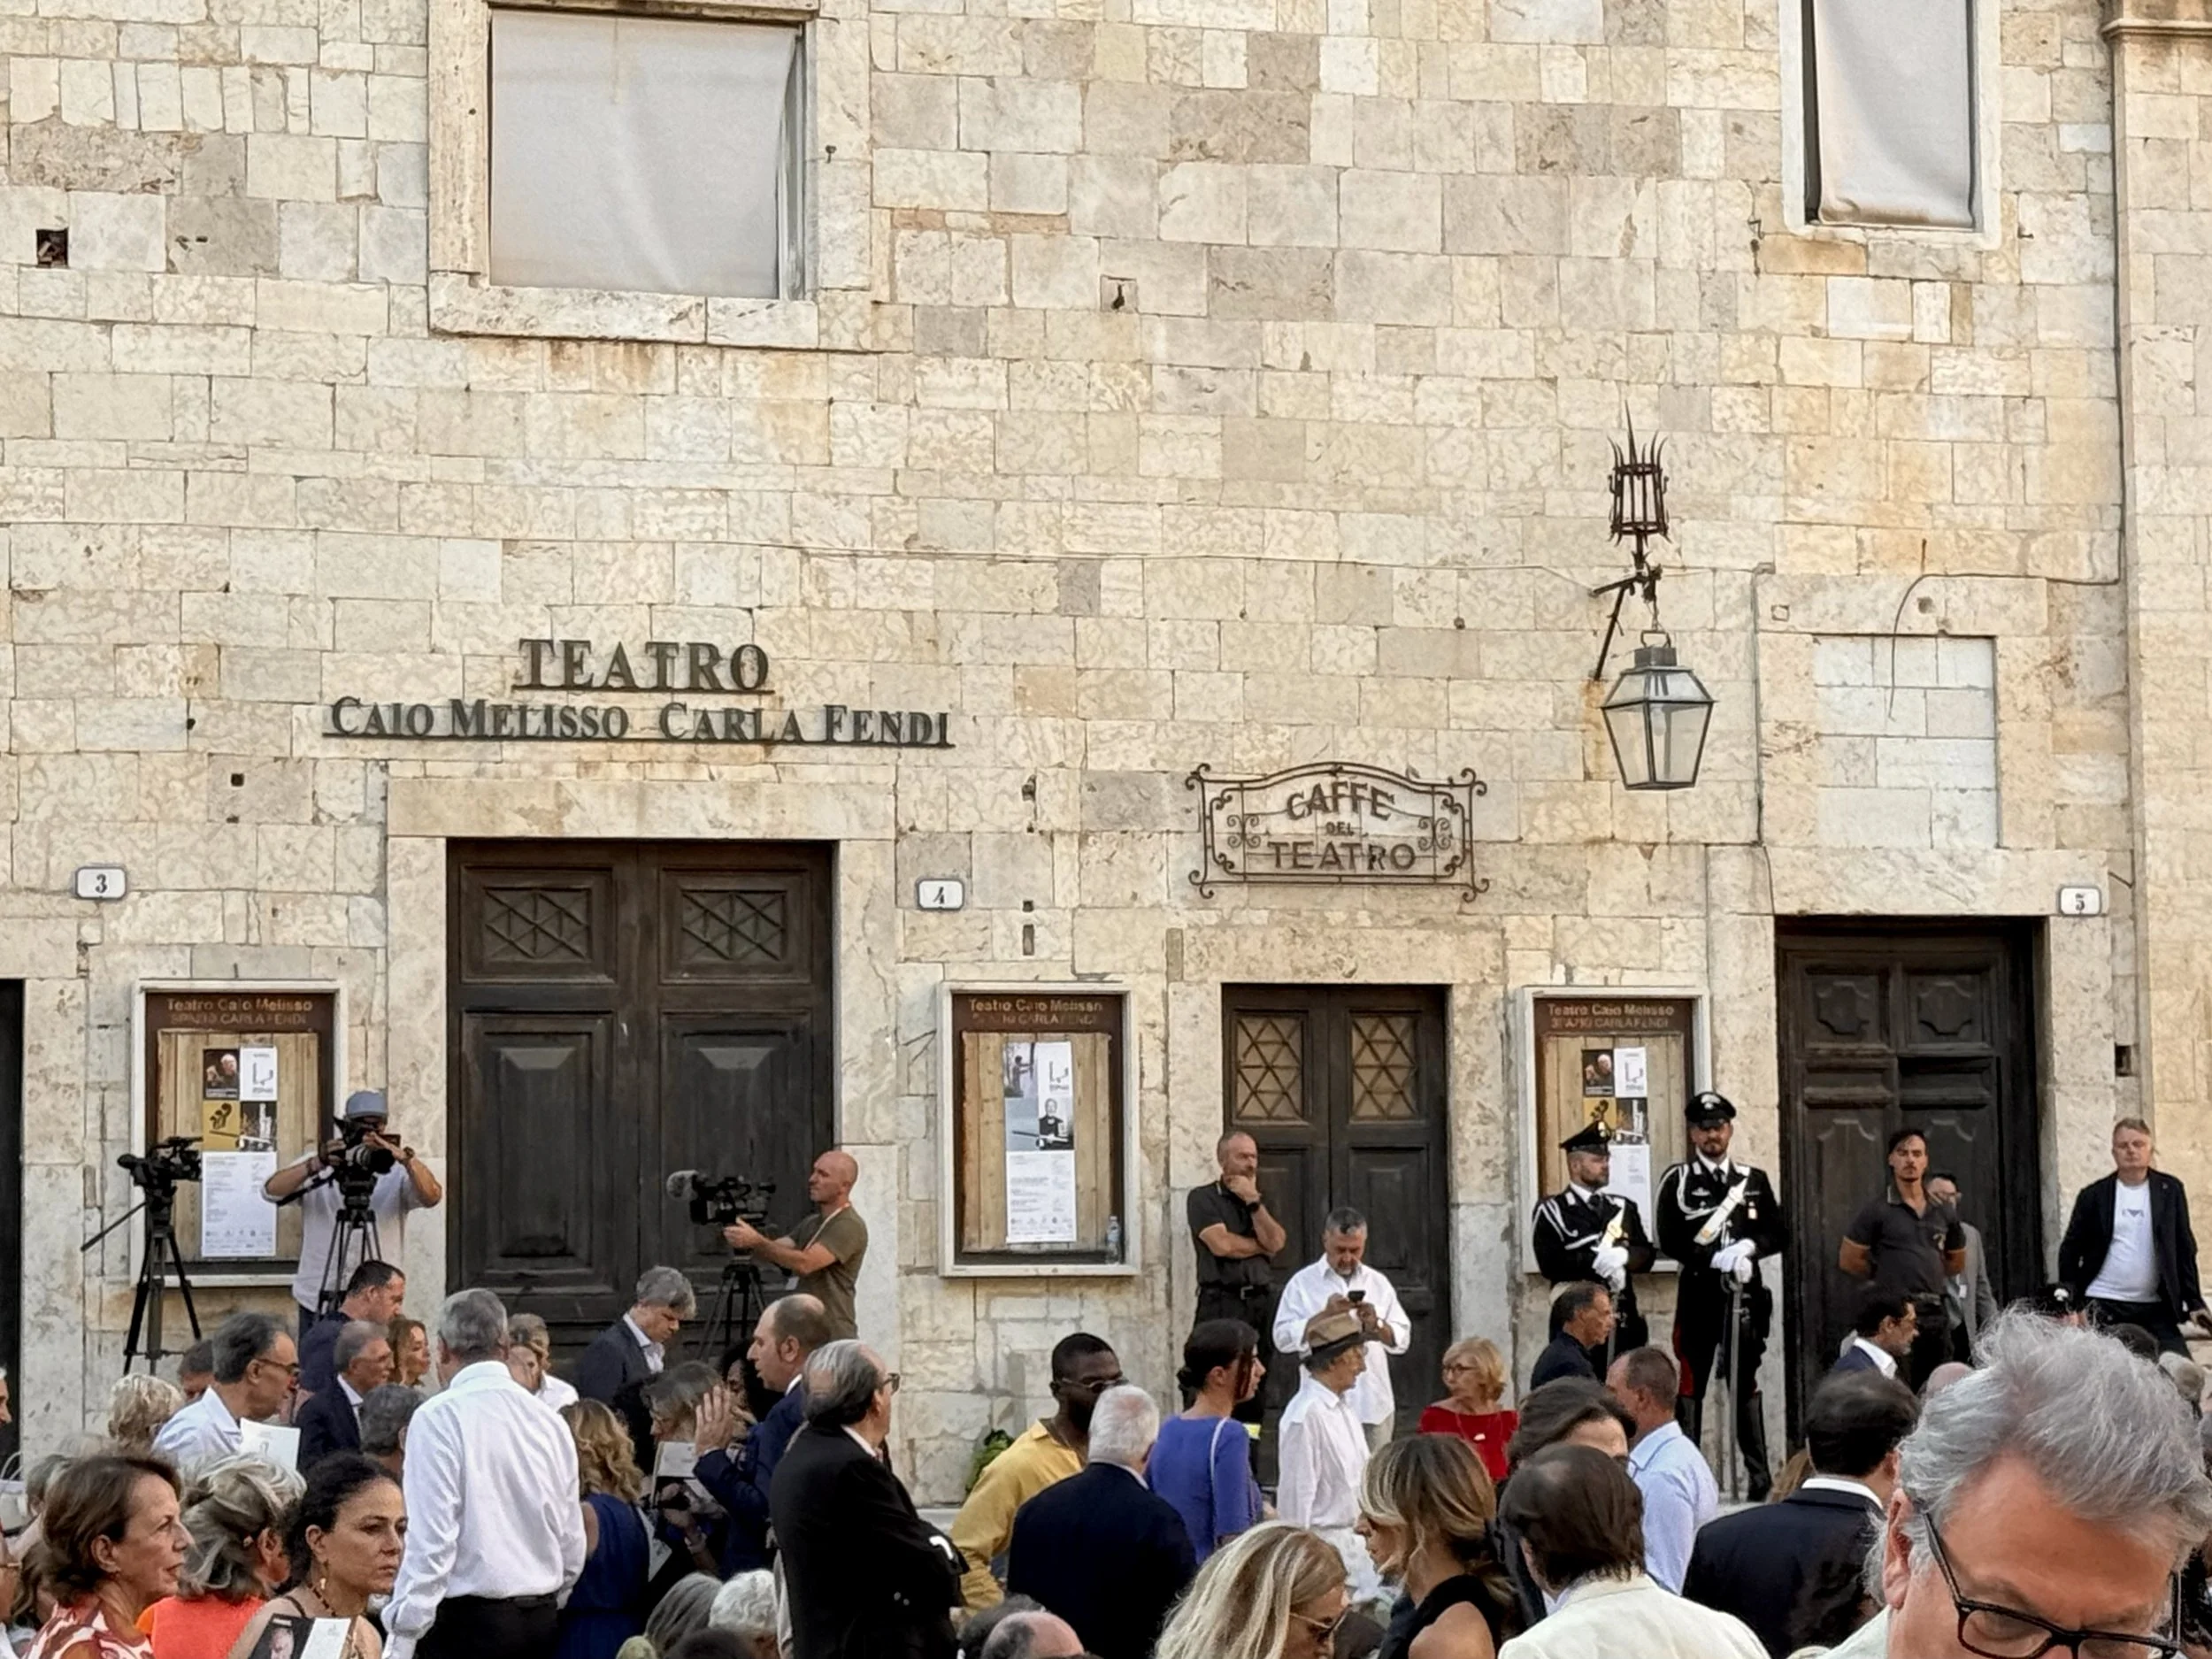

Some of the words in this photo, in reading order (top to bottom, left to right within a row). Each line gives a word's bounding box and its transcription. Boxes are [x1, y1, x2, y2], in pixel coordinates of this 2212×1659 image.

[518, 638, 769, 691] TEATRO
[331, 695, 434, 736] CAIO
[449, 698, 629, 739] MELISSO
[658, 702, 805, 743] CARLA
[824, 703, 950, 747] FENDI
[1325, 821, 1355, 836] DEL
[1268, 841, 1416, 871] TEATRO
[95, 873, 107, 893] 3
[933, 887, 944, 903] 4
[2075, 893, 2085, 910] 5
[166, 998, 213, 1010] Teatro
[218, 998, 252, 1010] Caio
[256, 998, 313, 1011] Melisso
[969, 999, 1012, 1010] Teatro
[1548, 1003, 1588, 1016] Teatro
[1592, 1004, 1622, 1015] Caio
